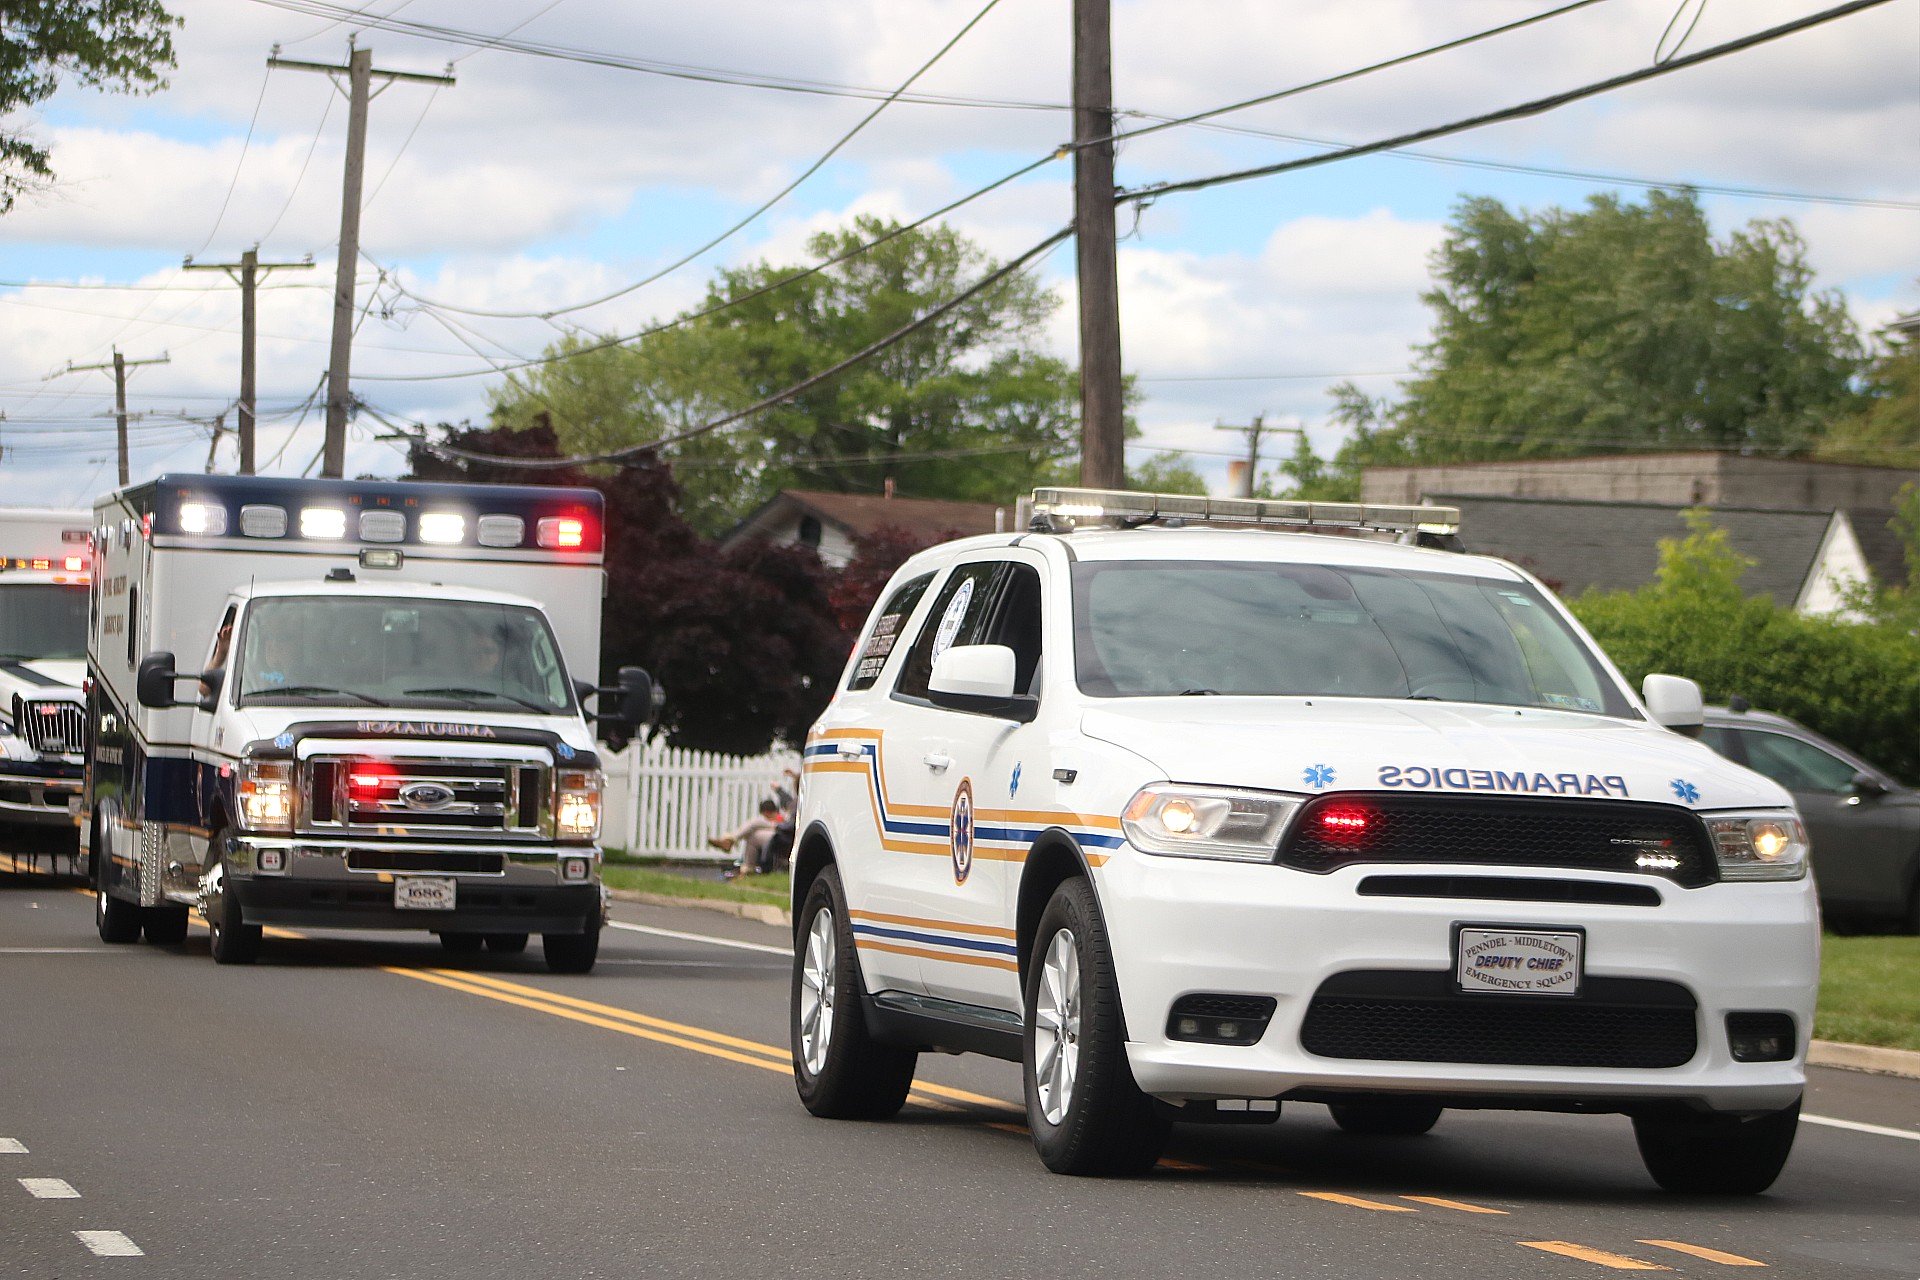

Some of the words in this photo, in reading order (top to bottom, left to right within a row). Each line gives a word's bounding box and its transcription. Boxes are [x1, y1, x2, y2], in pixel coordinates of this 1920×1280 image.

[1610, 838, 1662, 846] DODGE
[408, 888, 443, 899] 1686
[1465, 937, 1507, 958] PENNDEL
[1514, 936, 1575, 962] MIDDLETOWN
[1475, 955, 1523, 969] DEPUTY
[1526, 957, 1565, 971] CHIEF
[1465, 966, 1532, 989] EMERGENCY
[1536, 970, 1574, 988] SQUAD
